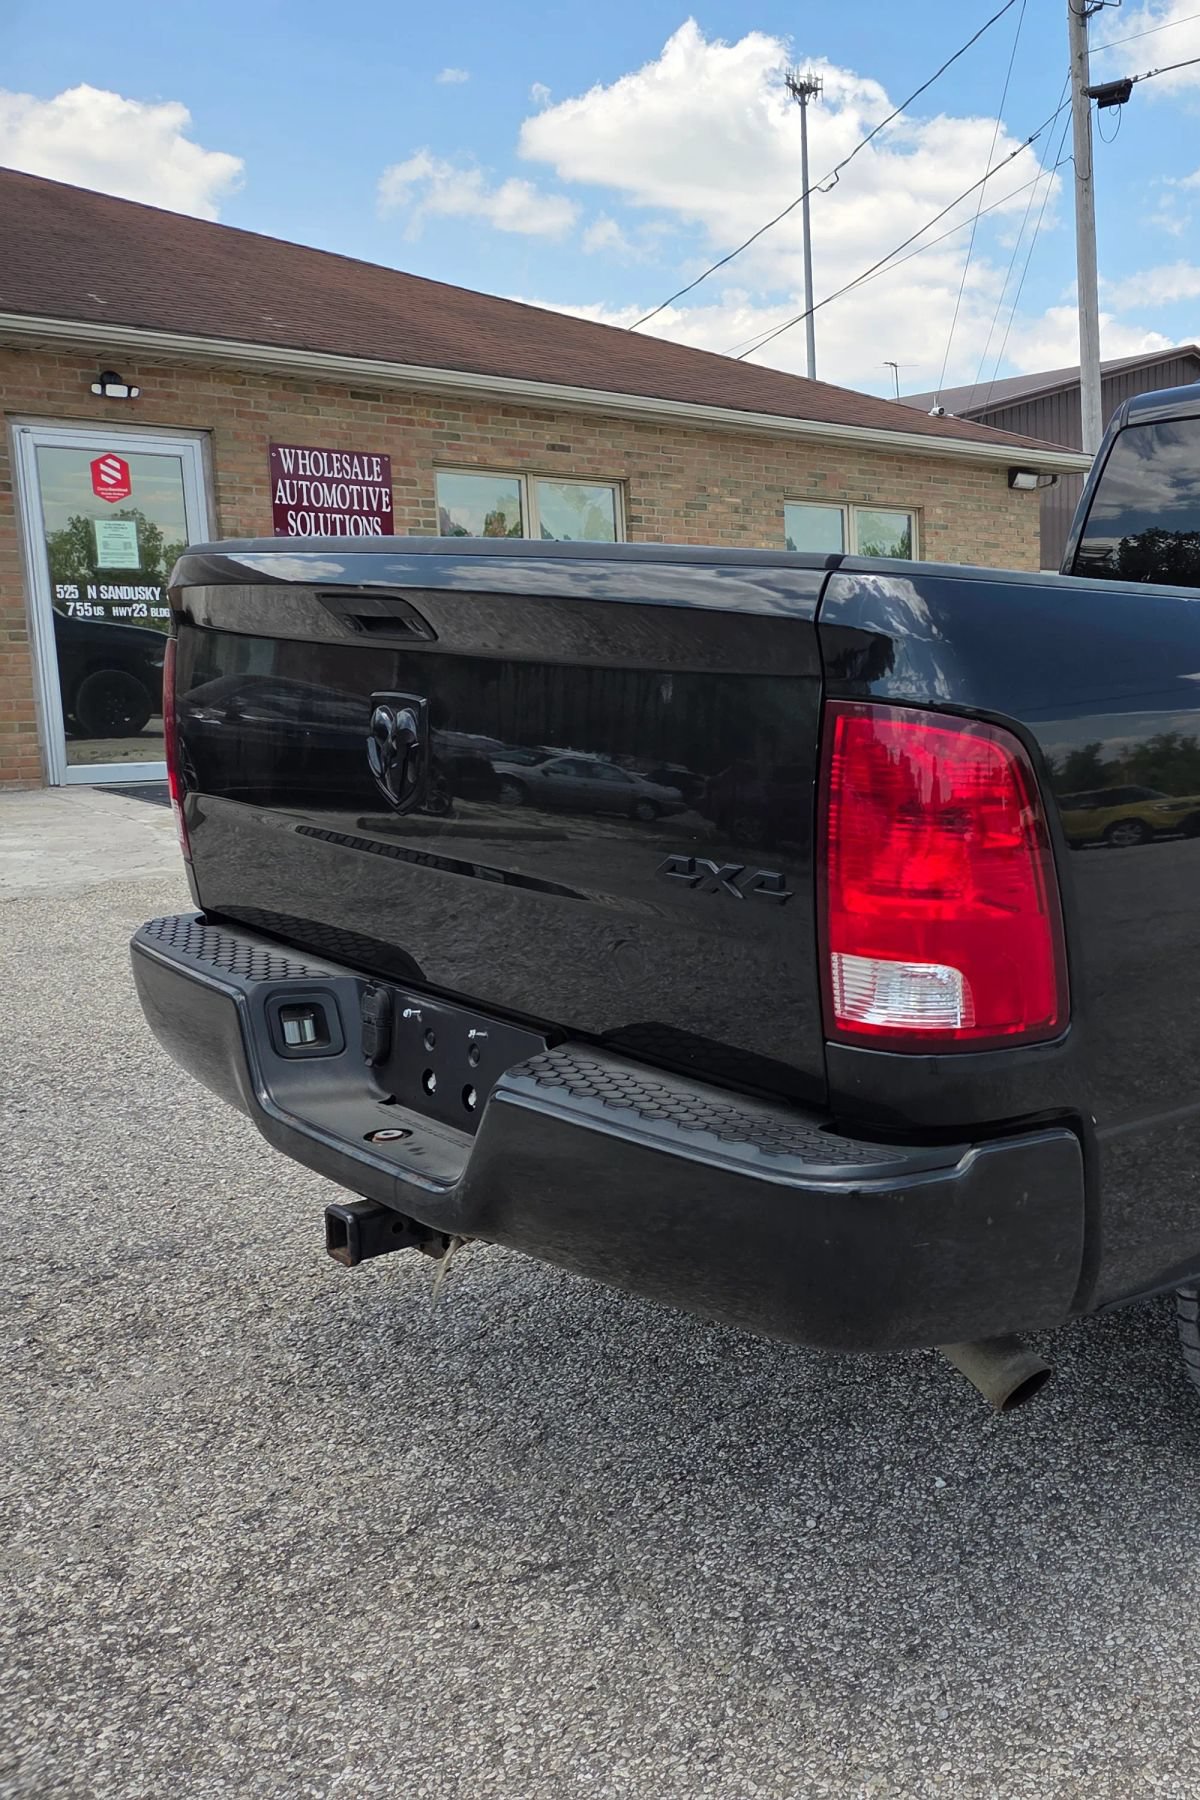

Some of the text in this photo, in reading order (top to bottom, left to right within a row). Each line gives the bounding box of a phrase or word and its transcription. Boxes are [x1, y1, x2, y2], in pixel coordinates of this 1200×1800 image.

[278, 448, 383, 482] WHOLESALE
[274, 479, 391, 512] AUTOMOTIVE
[287, 510, 382, 536] SOLUTIONS
[55, 584, 79, 599] 525
[87, 585, 97, 599] N
[100, 585, 161, 600] SANDUSKY
